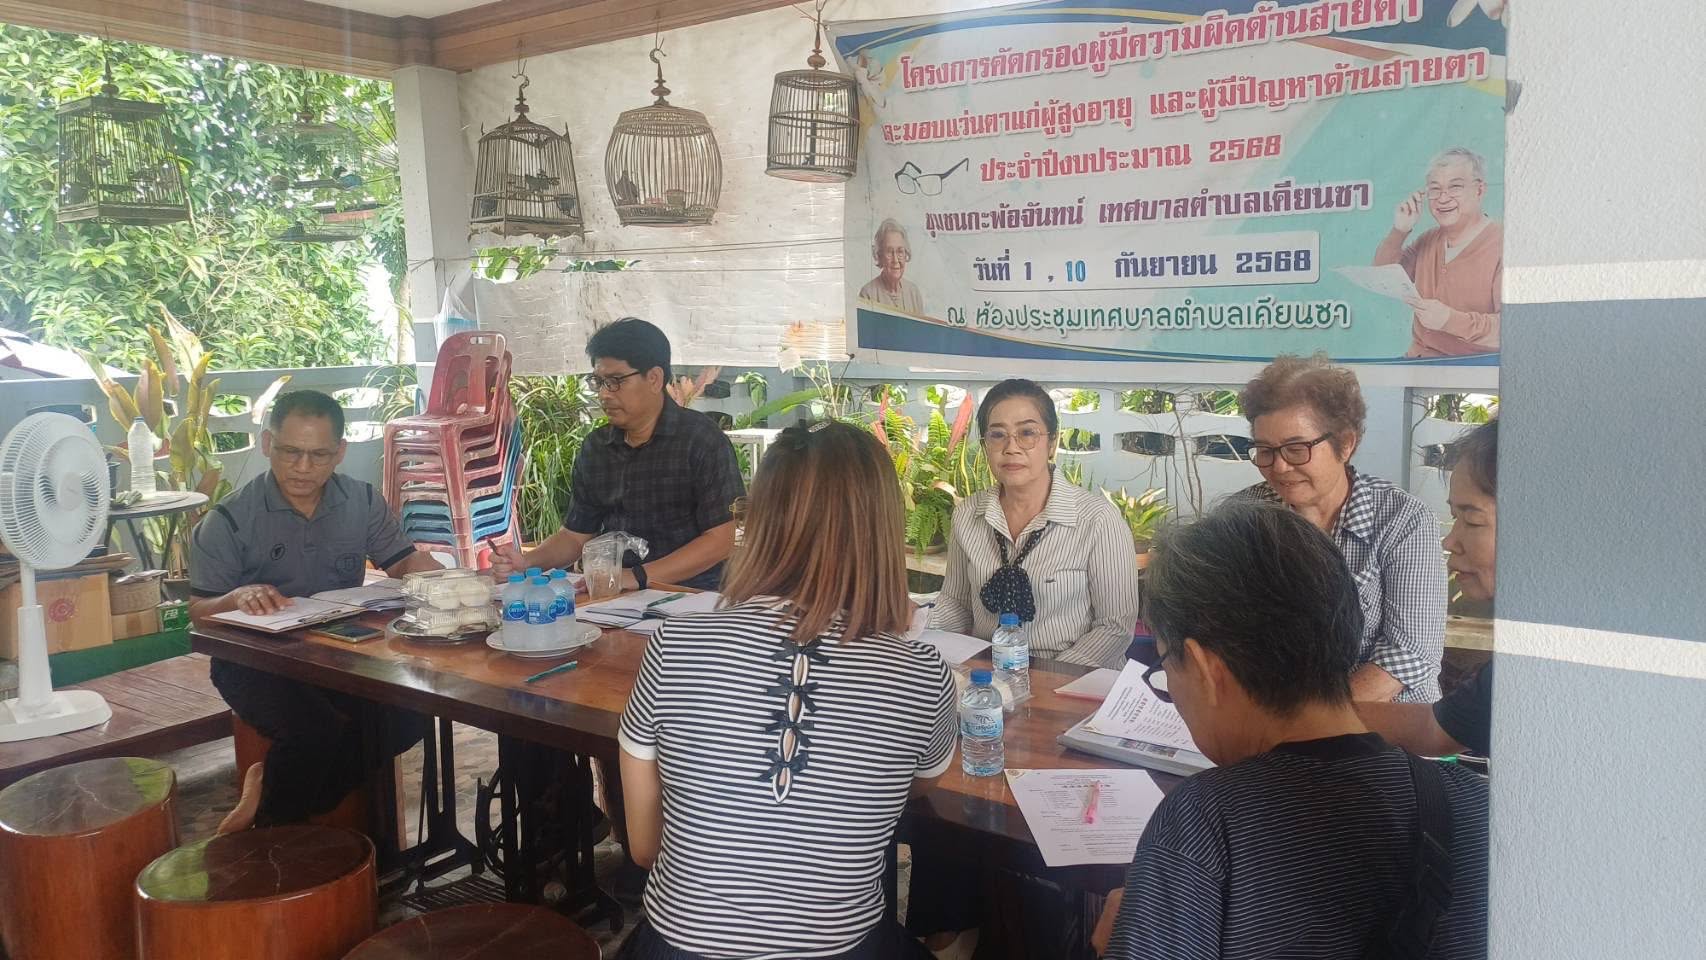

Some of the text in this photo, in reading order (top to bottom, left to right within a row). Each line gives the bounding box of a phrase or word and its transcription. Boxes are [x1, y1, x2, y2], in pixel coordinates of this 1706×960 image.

[882, 51, 1485, 142] ละมอบแว่นตาแก่ผู้สูงอายุ และผู้มีปัญหาด้านสายตา
[979, 135, 1281, 182] ประจำปีงบประมาณ 2568
[1099, 180, 1369, 224] เทศบาลตำบลเคียนซา
[973, 248, 1011, 281] วันที่
[1024, 261, 1032, 281] 1
[1065, 260, 1086, 282] 10
[1114, 251, 1218, 279] กันยายน
[1236, 249, 1312, 274] 2568
[947, 298, 1349, 336] ณ ห้องประชุมเทศบาลตำบลเคียนซา
